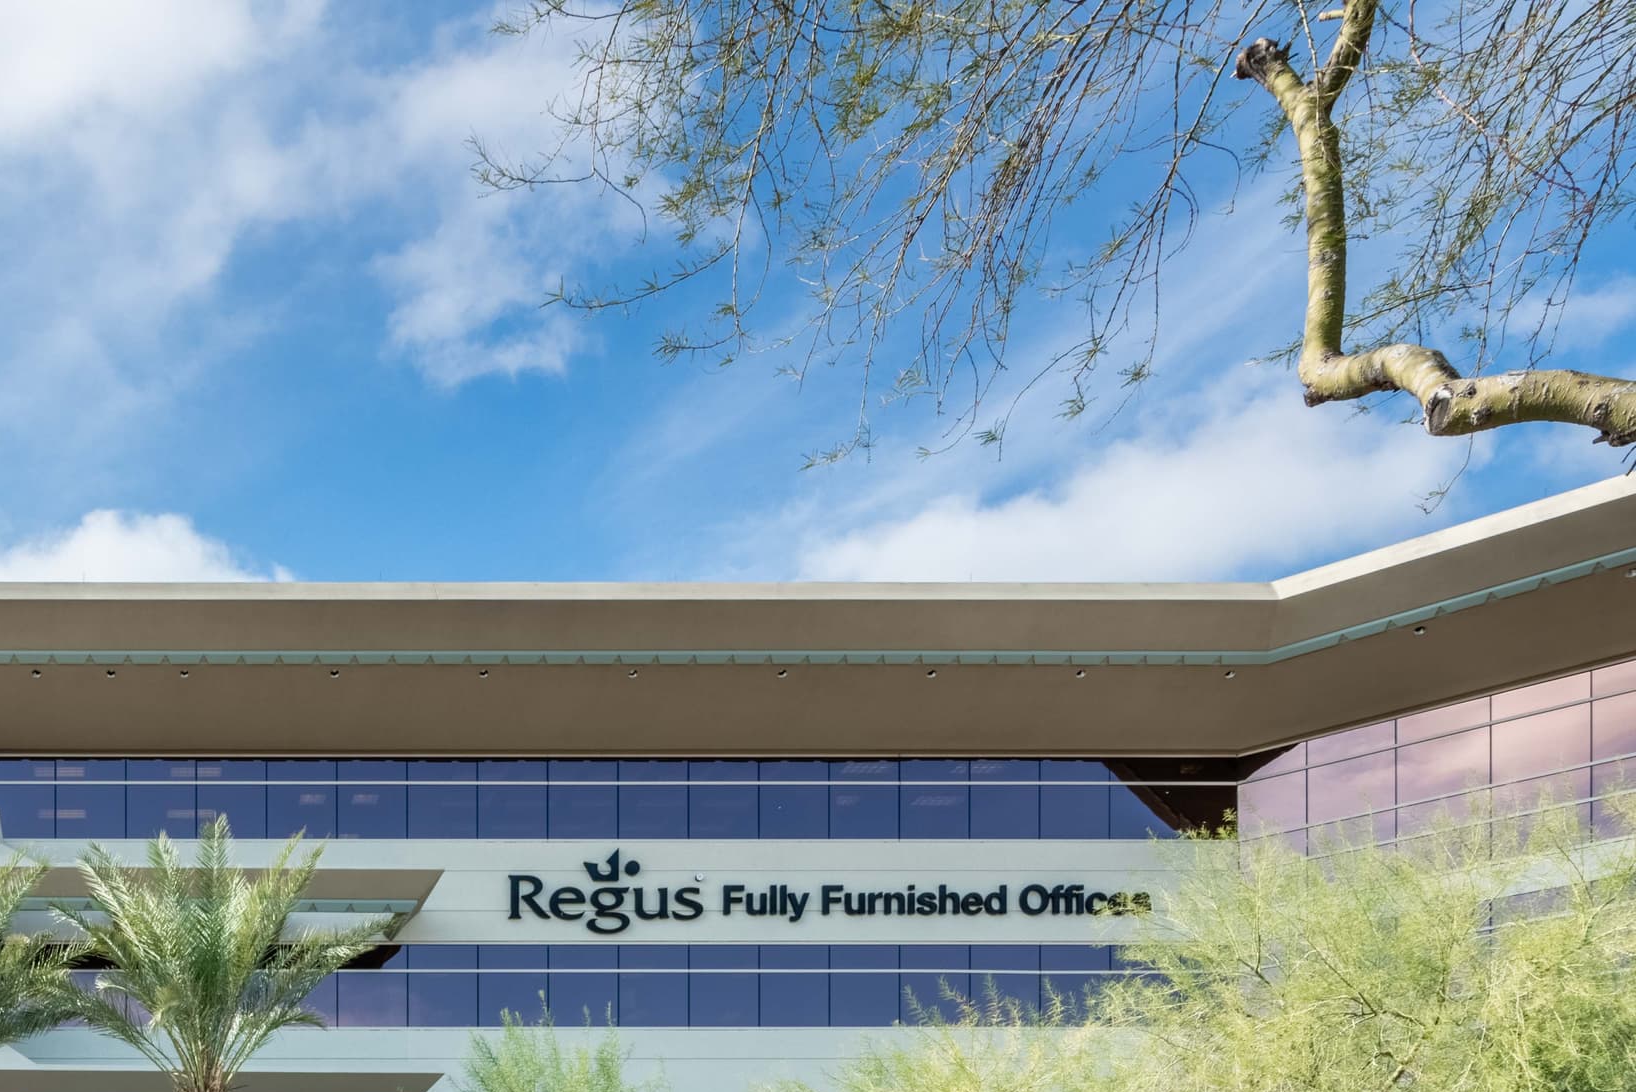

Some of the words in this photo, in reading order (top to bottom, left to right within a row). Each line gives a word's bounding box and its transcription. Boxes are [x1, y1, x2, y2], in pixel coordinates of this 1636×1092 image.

[507, 874, 704, 935] Regus
[722, 884, 810, 923] Fully
[821, 883, 1008, 916] Furnished
